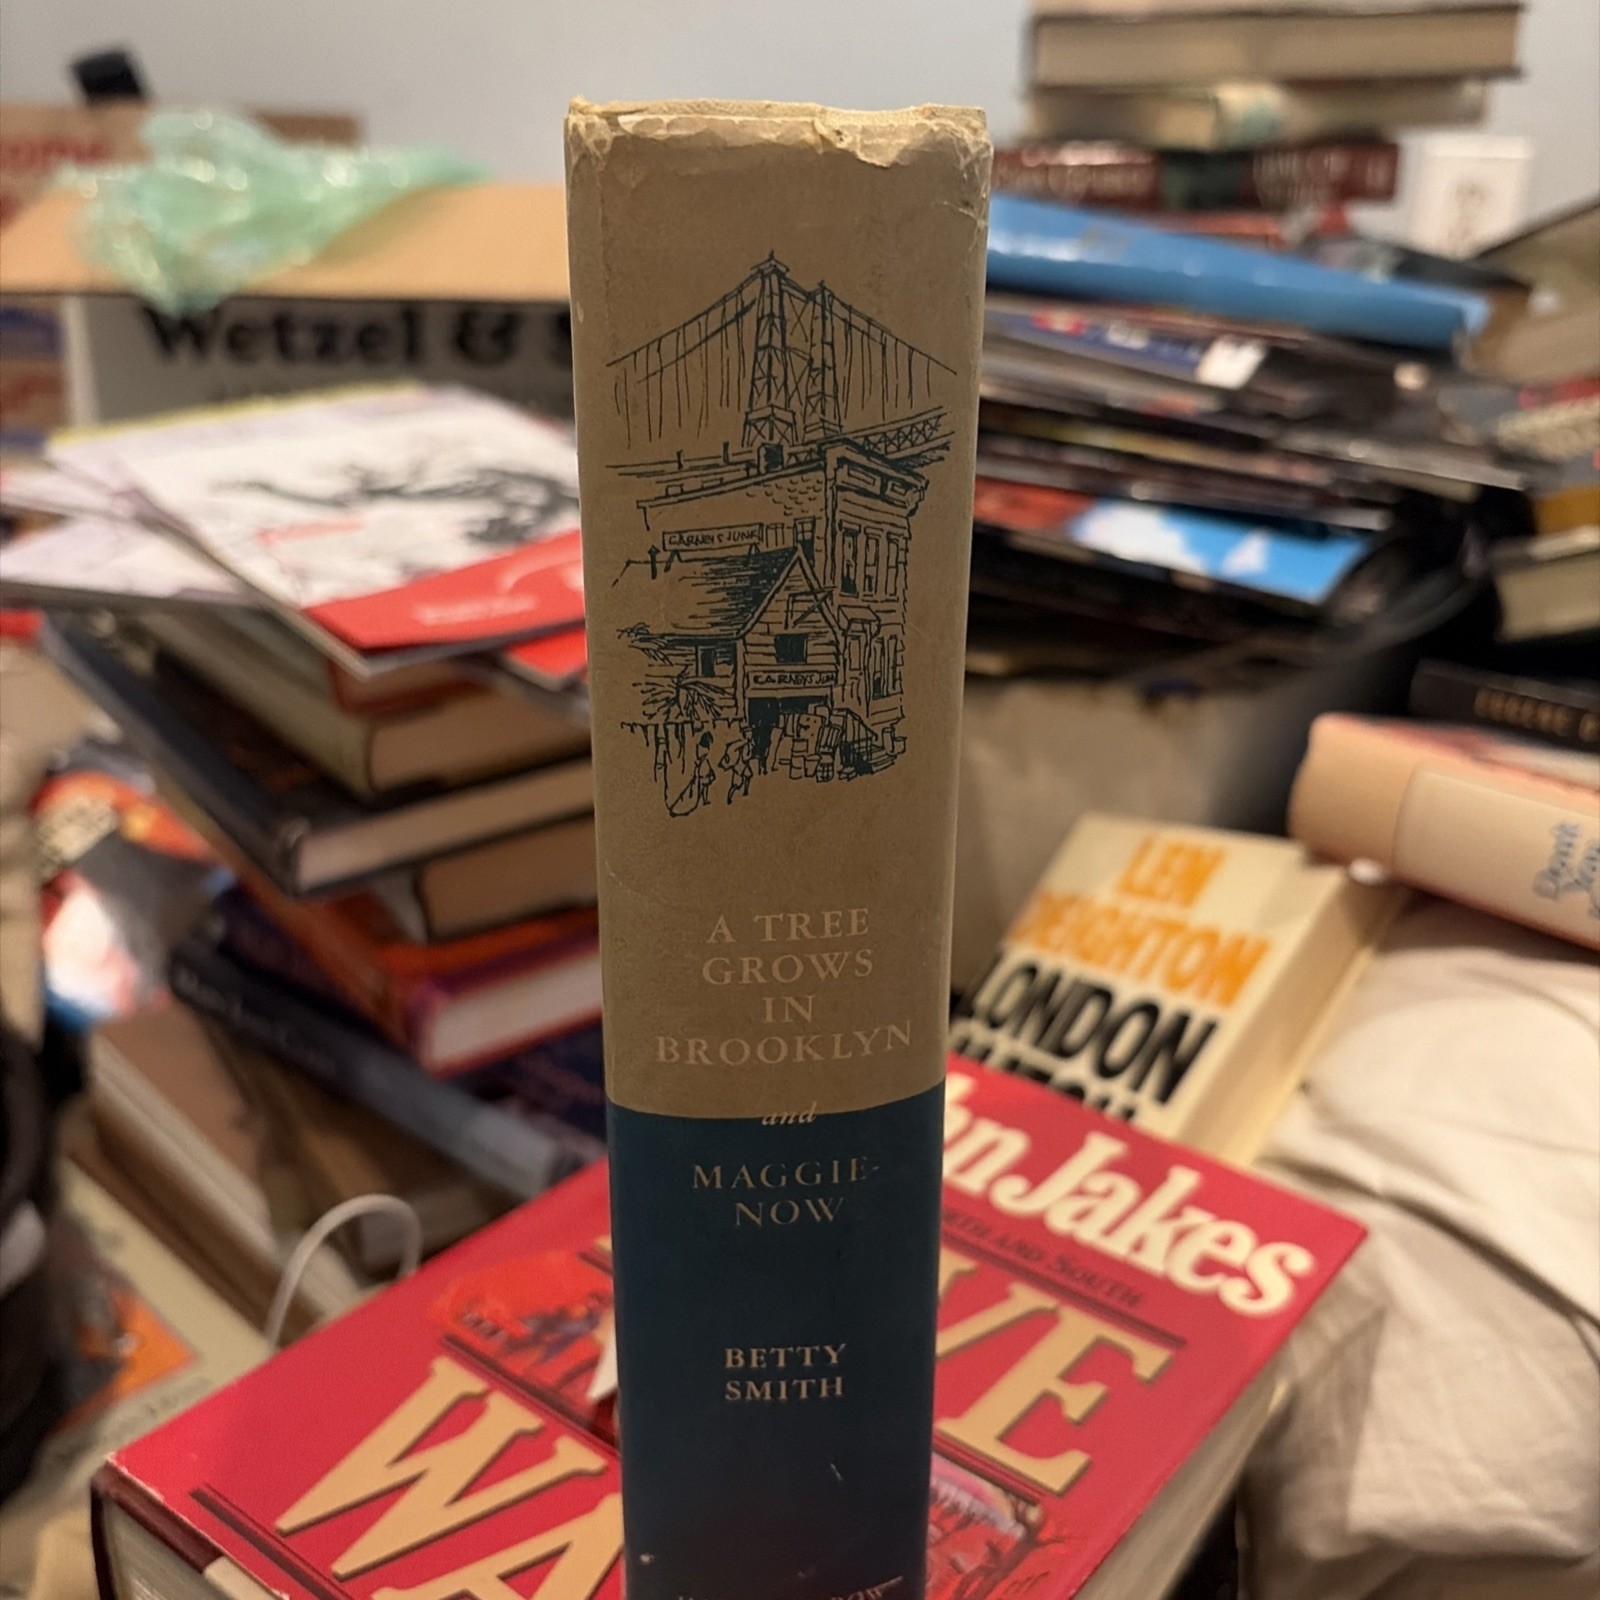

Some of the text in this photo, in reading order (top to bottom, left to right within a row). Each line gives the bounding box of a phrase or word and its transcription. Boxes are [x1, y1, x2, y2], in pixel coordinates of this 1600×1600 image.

[1115, 834, 1226, 908] LEN
[707, 908, 870, 943] A TREE
[702, 948, 875, 985] GROWS
[762, 994, 817, 1024] IN
[655, 1020, 912, 1066] BROOKLYN
[966, 956, 1219, 1105] LONDON
[761, 1101, 818, 1126] and
[692, 1157, 880, 1190] MAGGIE-
[735, 1197, 844, 1228] NOW
[944, 1073, 1031, 1195] hn
[990, 1132, 1314, 1320] Jakes
[724, 1343, 848, 1369] BETTY
[724, 1376, 844, 1402] SMITH
